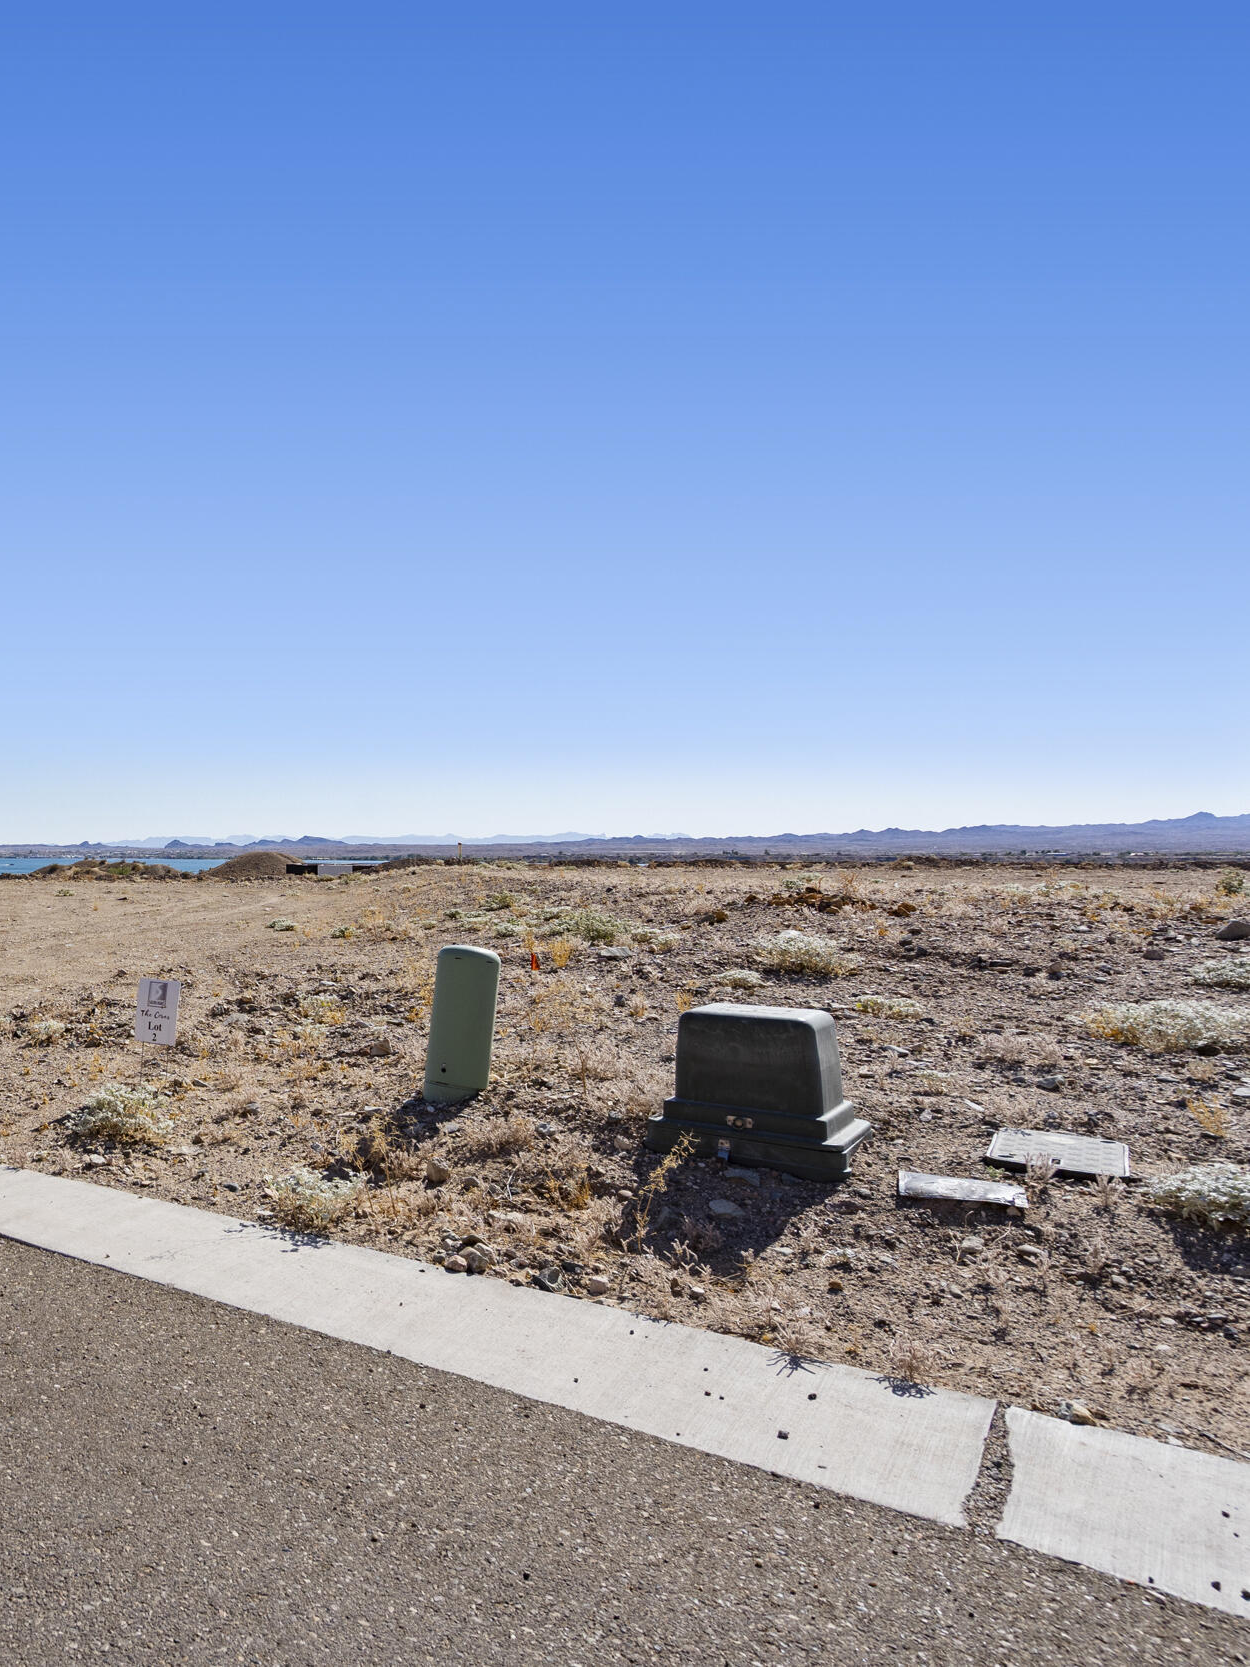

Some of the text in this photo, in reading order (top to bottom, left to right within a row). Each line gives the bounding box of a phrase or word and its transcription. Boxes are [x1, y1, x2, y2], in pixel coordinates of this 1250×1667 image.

[141, 1009, 152, 1018] The
[148, 1021, 162, 1031] Lot
[152, 1032, 157, 1041] 2
